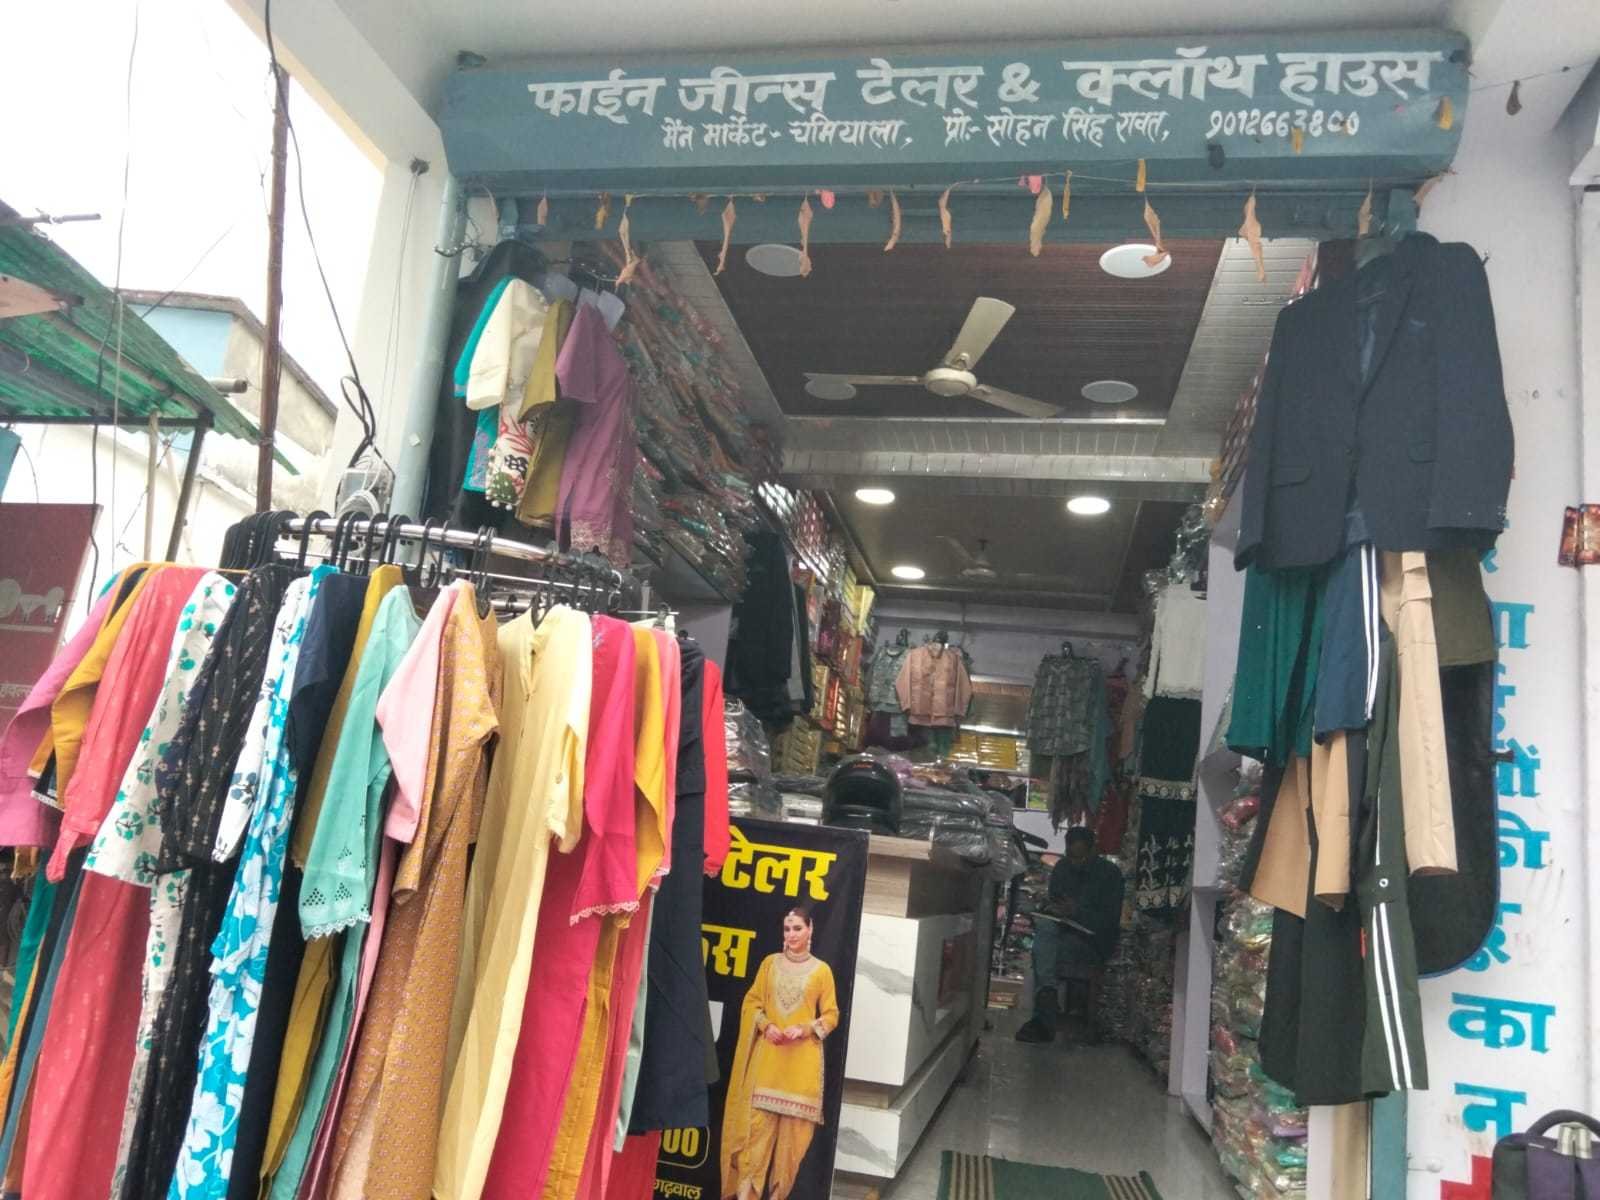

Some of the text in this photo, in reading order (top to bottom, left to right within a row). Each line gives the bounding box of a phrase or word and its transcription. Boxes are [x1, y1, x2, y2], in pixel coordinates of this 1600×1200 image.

[527, 46, 1444, 124] फाईन जीन्स टेलर & क्लॉथ हाउस
[984, 106, 1056, 147] सोहन
[1062, 105, 1113, 148] सिंह
[721, 824, 837, 901] टेलर
